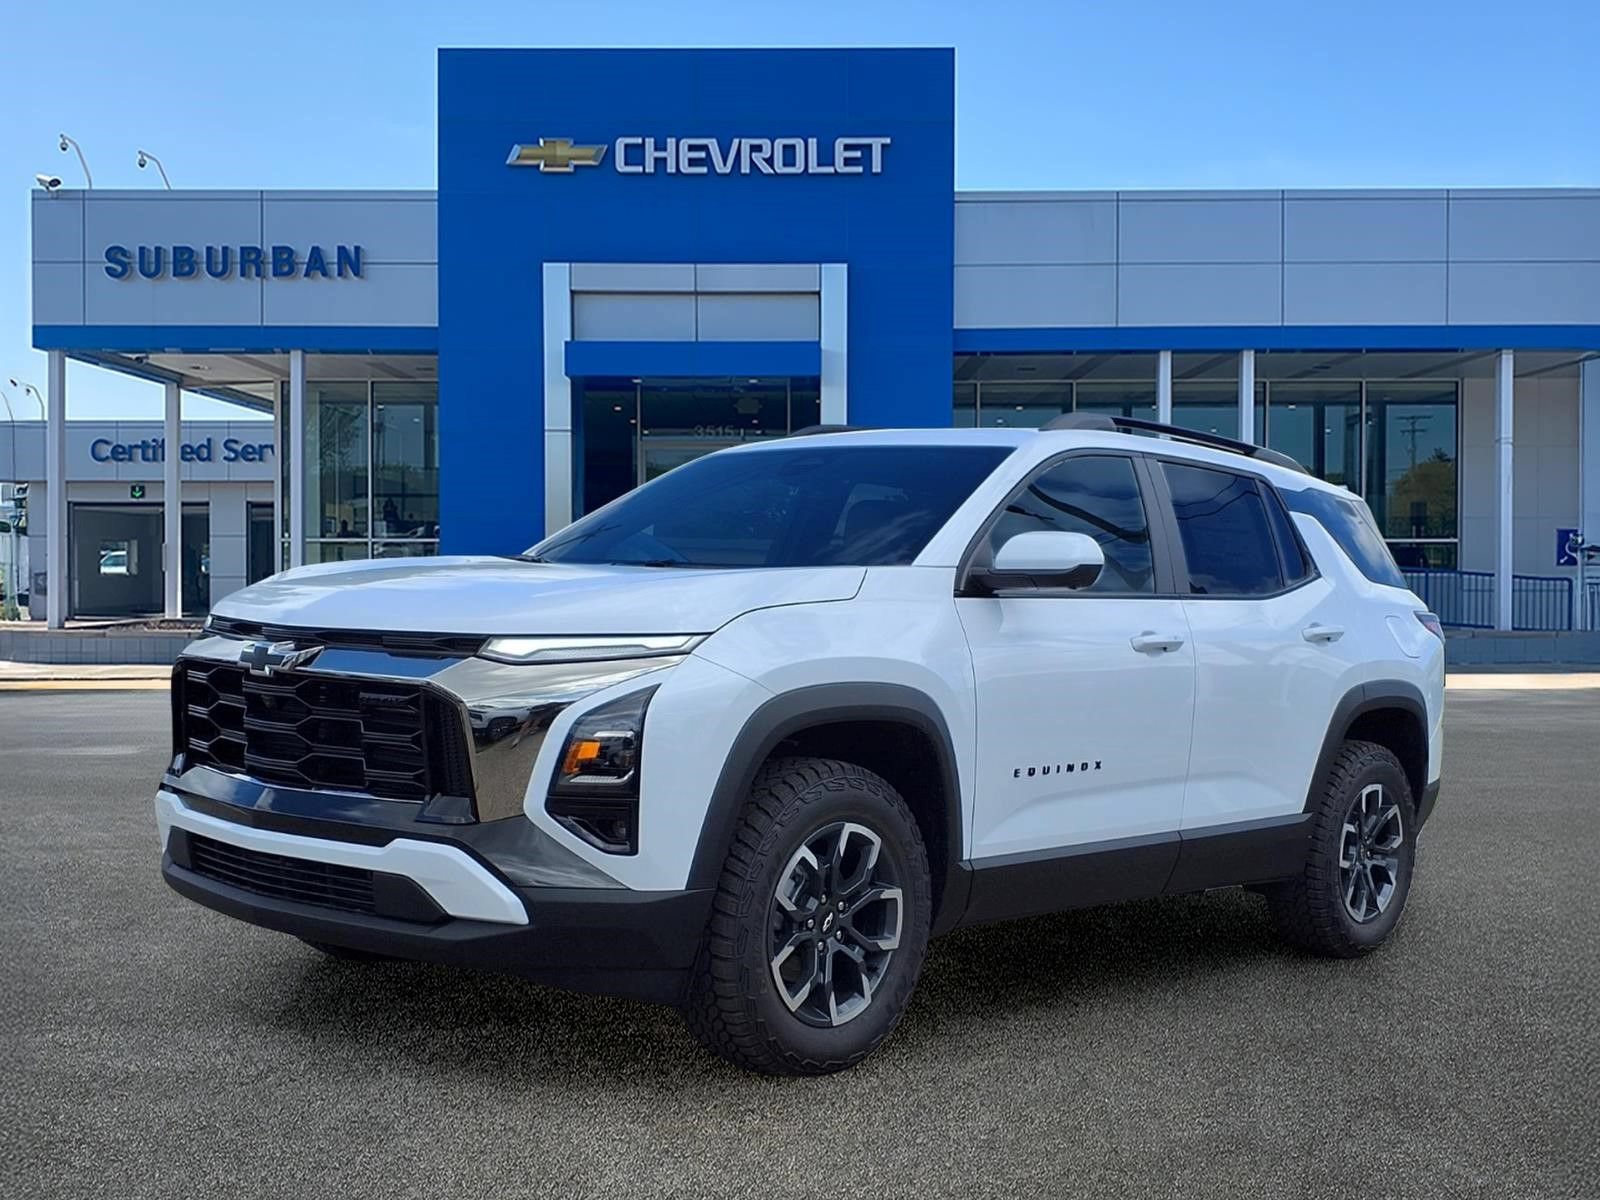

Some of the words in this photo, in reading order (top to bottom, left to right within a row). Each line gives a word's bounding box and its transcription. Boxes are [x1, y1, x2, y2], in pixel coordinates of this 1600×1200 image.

[614, 136, 891, 175] CHEVROLET
[103, 245, 364, 280] SUBURBAN
[91, 437, 213, 463] Certifed
[1013, 760, 1102, 779] EQUINOX
